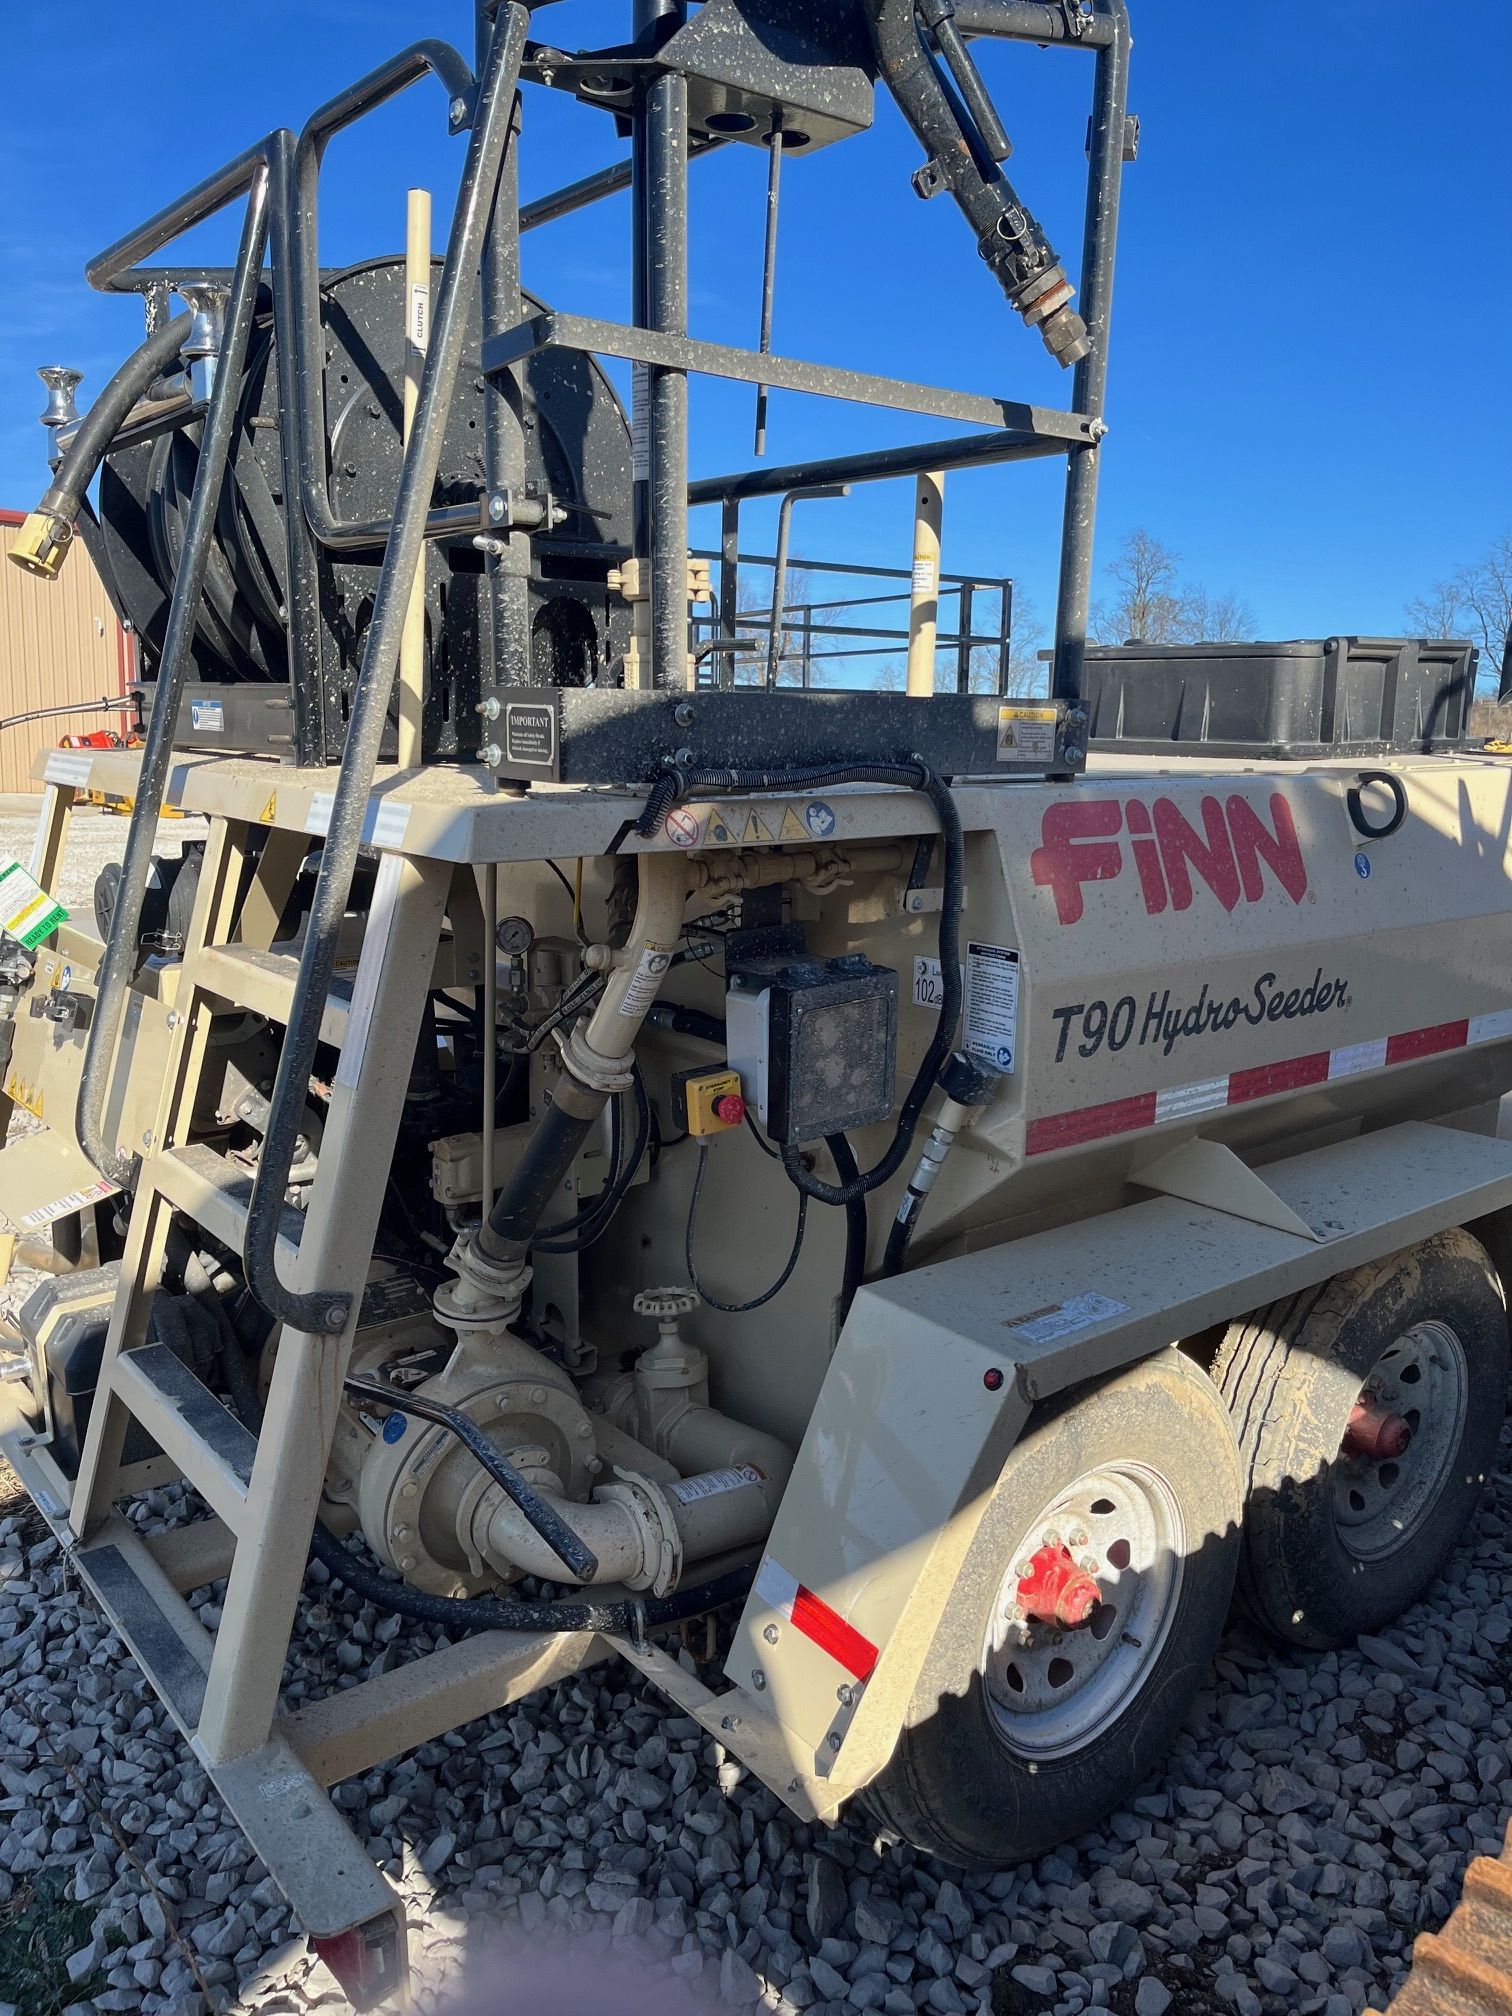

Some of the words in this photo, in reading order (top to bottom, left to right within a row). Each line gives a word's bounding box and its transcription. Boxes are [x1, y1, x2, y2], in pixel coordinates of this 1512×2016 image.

[1019, 711, 1044, 719] CAUTION
[511, 716, 549, 727] IMPORTANT
[25, 928, 43, 946] READY
[42, 920, 52, 931] TO
[51, 909, 65, 924] RENT
[1052, 995, 1136, 1063] T90
[1138, 967, 1348, 1056] HydroSeeder
[972, 1041, 996, 1051] HYDRAULIC
